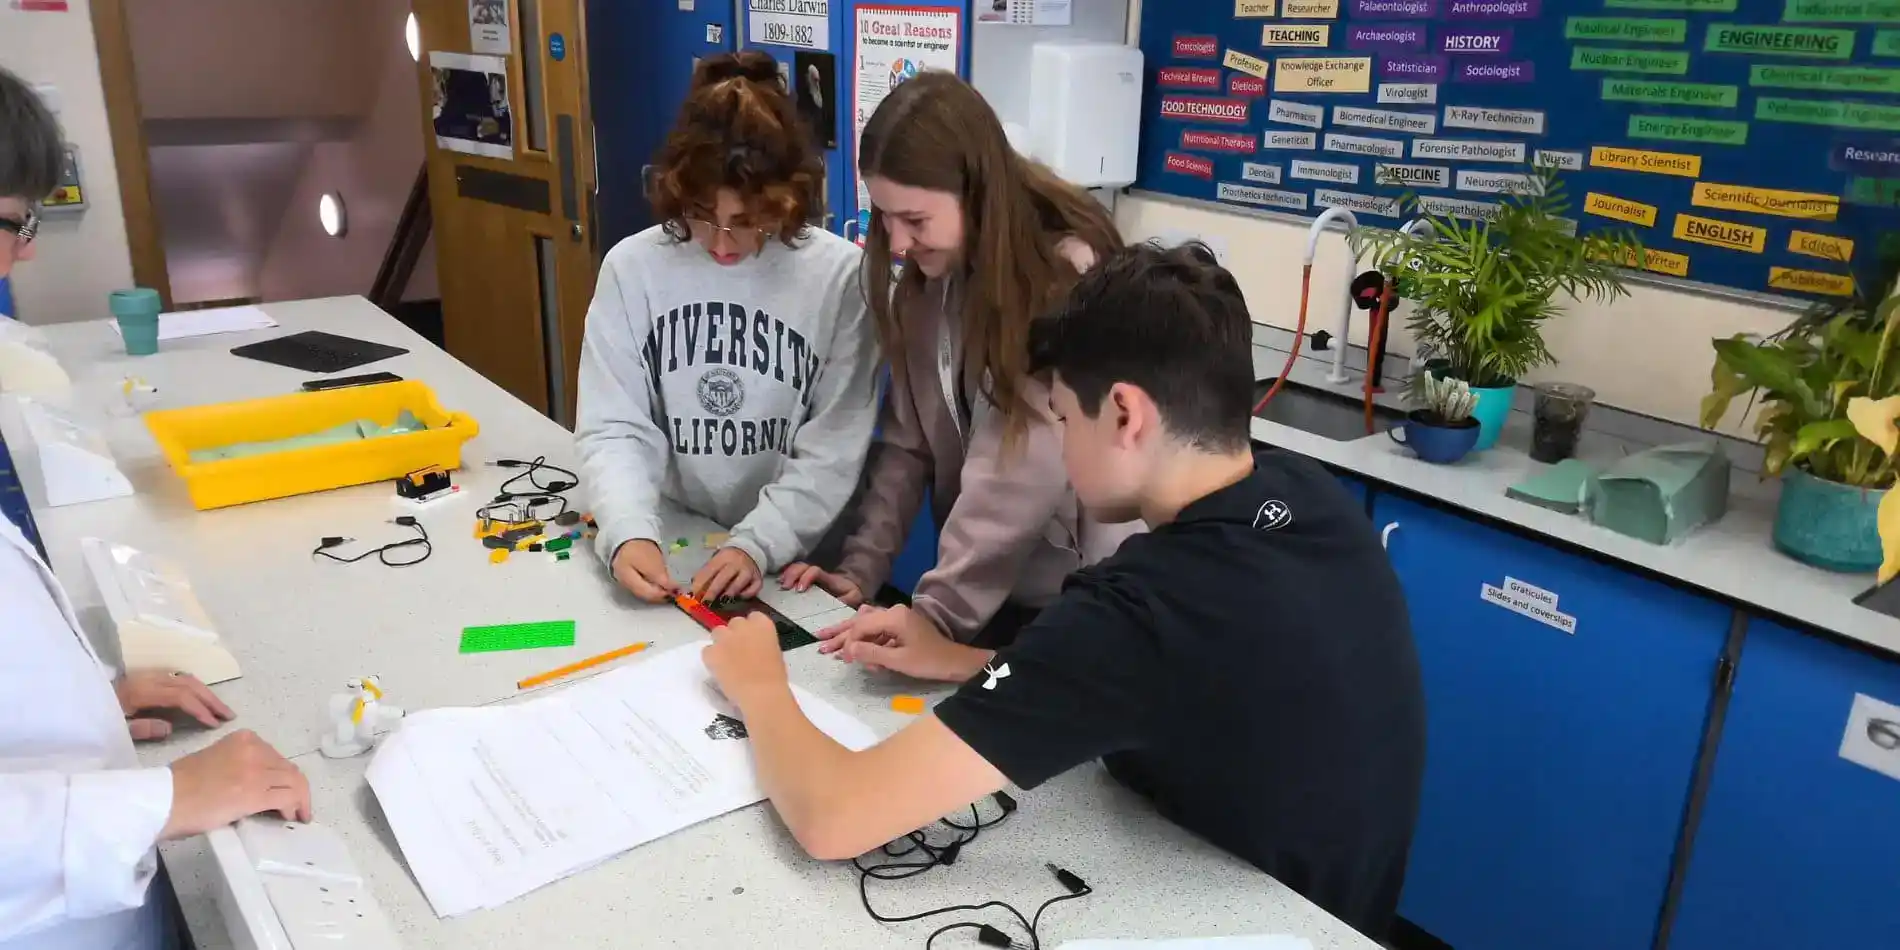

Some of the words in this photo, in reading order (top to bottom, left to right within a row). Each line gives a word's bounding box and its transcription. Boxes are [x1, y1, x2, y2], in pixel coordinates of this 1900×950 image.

[789, 0, 828, 15] Darwin
[1241, 3, 1269, 13] Teacher
[1287, 3, 1331, 14] Researcher
[1359, 1, 1428, 14] Palaeontologist
[1452, 1, 1528, 15] Anthropologist
[764, 22, 813, 43] 1809-1882
[860, 20, 869, 34] 10
[872, 20, 900, 36] Great
[904, 22, 952, 39] Reasons
[1269, 29, 1320, 43] TEACHING
[1355, 30, 1416, 43] Archaeologist
[1622, 24, 1675, 37] Engineer
[868, 37, 889, 47] become
[895, 38, 916, 48] scientist
[923, 43, 949, 51] engineer
[1175, 40, 1216, 54] Toxicologist
[1445, 35, 1501, 50] HISTORY
[1718, 30, 1839, 52] ENGINEERING
[1230, 53, 1263, 72] Professor
[1280, 61, 1324, 73] Knowledge
[1325, 61, 1365, 73] Exchange
[1387, 61, 1437, 74] Statistician
[1580, 53, 1623, 65] Nuclear
[1626, 56, 1678, 69] Engineer
[1160, 71, 1191, 82] Technical
[1191, 74, 1216, 84] Brewer
[1466, 65, 1521, 79] Sociologist
[1231, 81, 1264, 92] Dietician
[1306, 77, 1334, 87] Officer
[1385, 87, 1428, 100] Virologist
[1612, 83, 1668, 98] Materials
[1670, 86, 1725, 102] Engineer
[1161, 100, 1186, 115] FOOD
[1187, 102, 1248, 118] TECHNOLOGY
[1275, 107, 1317, 124] Pharmacist
[1339, 110, 1387, 125] Biomedical
[1388, 115, 1429, 129] Engineer
[1450, 110, 1480, 123] X-Ray
[1481, 111, 1535, 125] Technician
[1638, 120, 1678, 134] Energy
[1681, 122, 1736, 139] Engineer
[1183, 133, 1219, 146] Nutritional
[1220, 136, 1254, 150] Therapist
[1271, 135, 1309, 145] Geneticist
[1330, 139, 1396, 156] Pharmacologist
[1419, 142, 1459, 154] Forensic
[1461, 144, 1516, 159] Pathologist
[1167, 156, 1186, 168] Food
[1186, 159, 1213, 174] Scientist
[1542, 153, 1574, 165] Nurse
[1599, 150, 1639, 168] Library
[1640, 154, 1692, 171] Scientist
[1248, 167, 1275, 179] Dentist
[1297, 165, 1353, 180] Immunologist
[1384, 166, 1441, 183] MEDICINE
[1464, 175, 1535, 190] Neuroscientis
[1222, 187, 1261, 199] Prosthetics
[1262, 191, 1301, 205] technician
[1704, 187, 1761, 206] Scientific
[1761, 194, 1829, 213] Journalist
[1592, 197, 1647, 219] Journalist
[1686, 219, 1755, 248] ENGLISH
[1800, 238, 1840, 254] Editor
[641, 301, 820, 408] NIVERSITY
[1510, 581, 1553, 605] Graticules
[1487, 587, 1511, 604] Slides
[1512, 598, 1529, 611] and
[1530, 605, 1573, 629] coverslips
